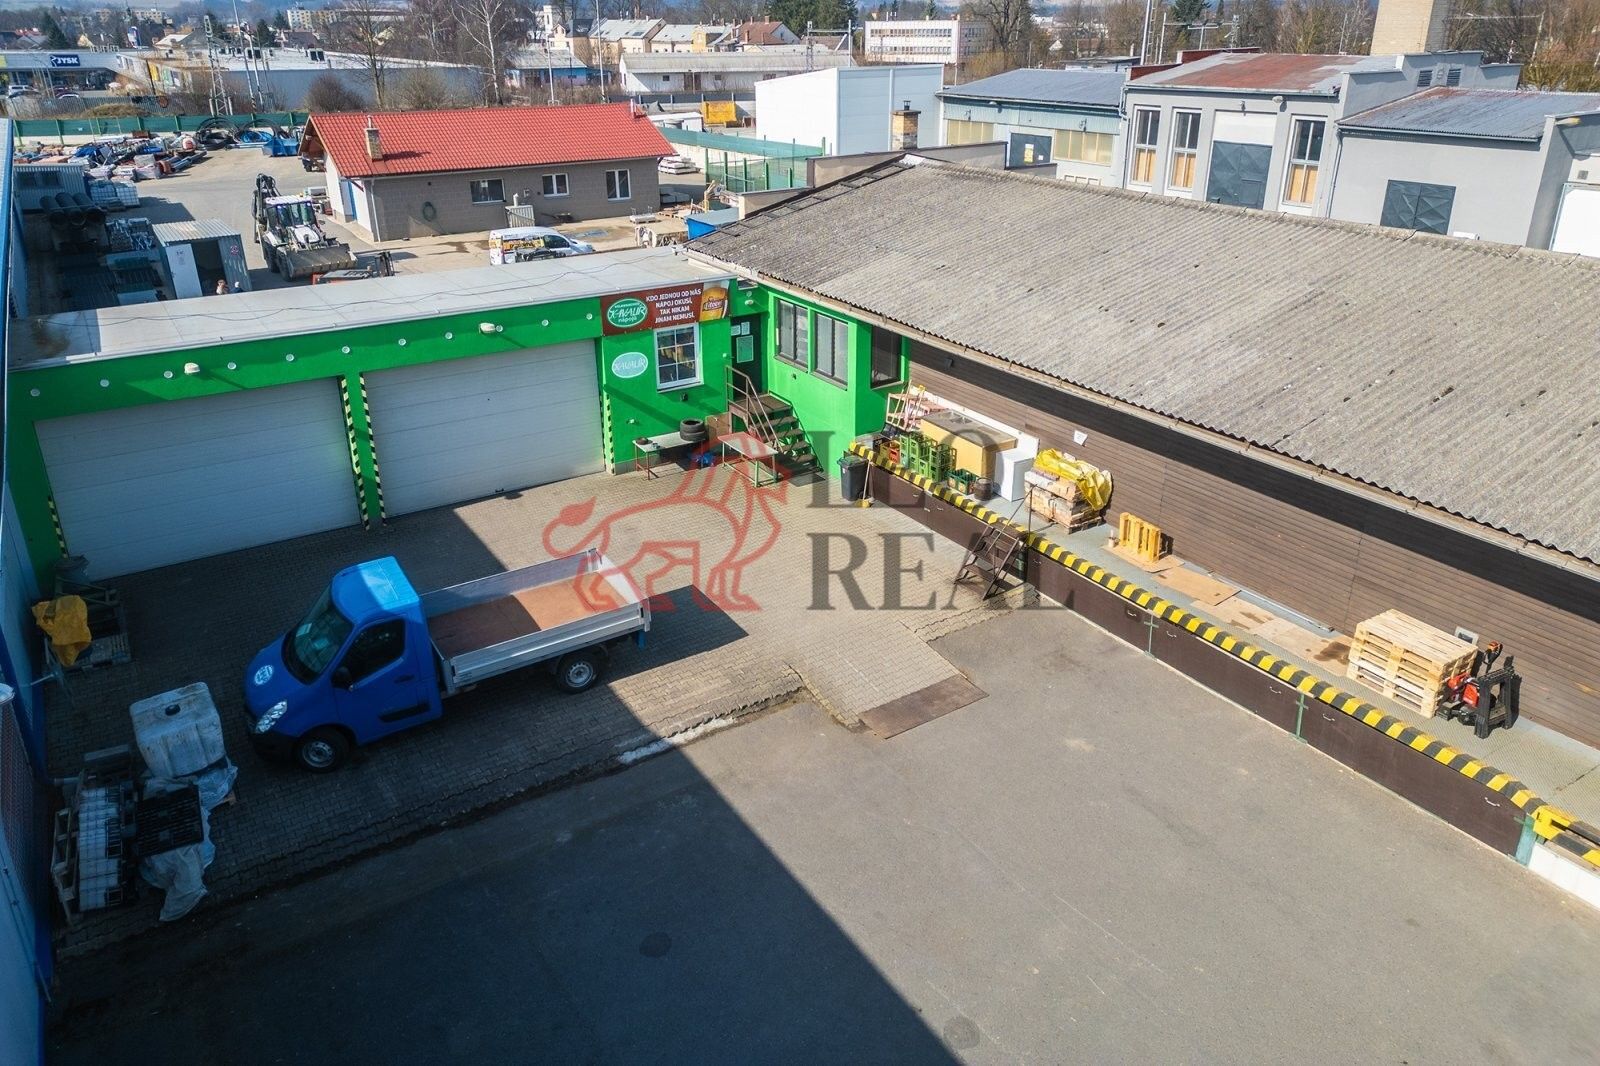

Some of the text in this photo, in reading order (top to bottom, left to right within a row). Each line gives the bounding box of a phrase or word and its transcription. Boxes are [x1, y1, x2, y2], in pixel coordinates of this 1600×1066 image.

[690, 288, 702, 296] NÁS
[655, 300, 674, 308] NÁPOJ
[659, 305, 690, 316] TAK NIKAM
[655, 316, 673, 324] JINAM
